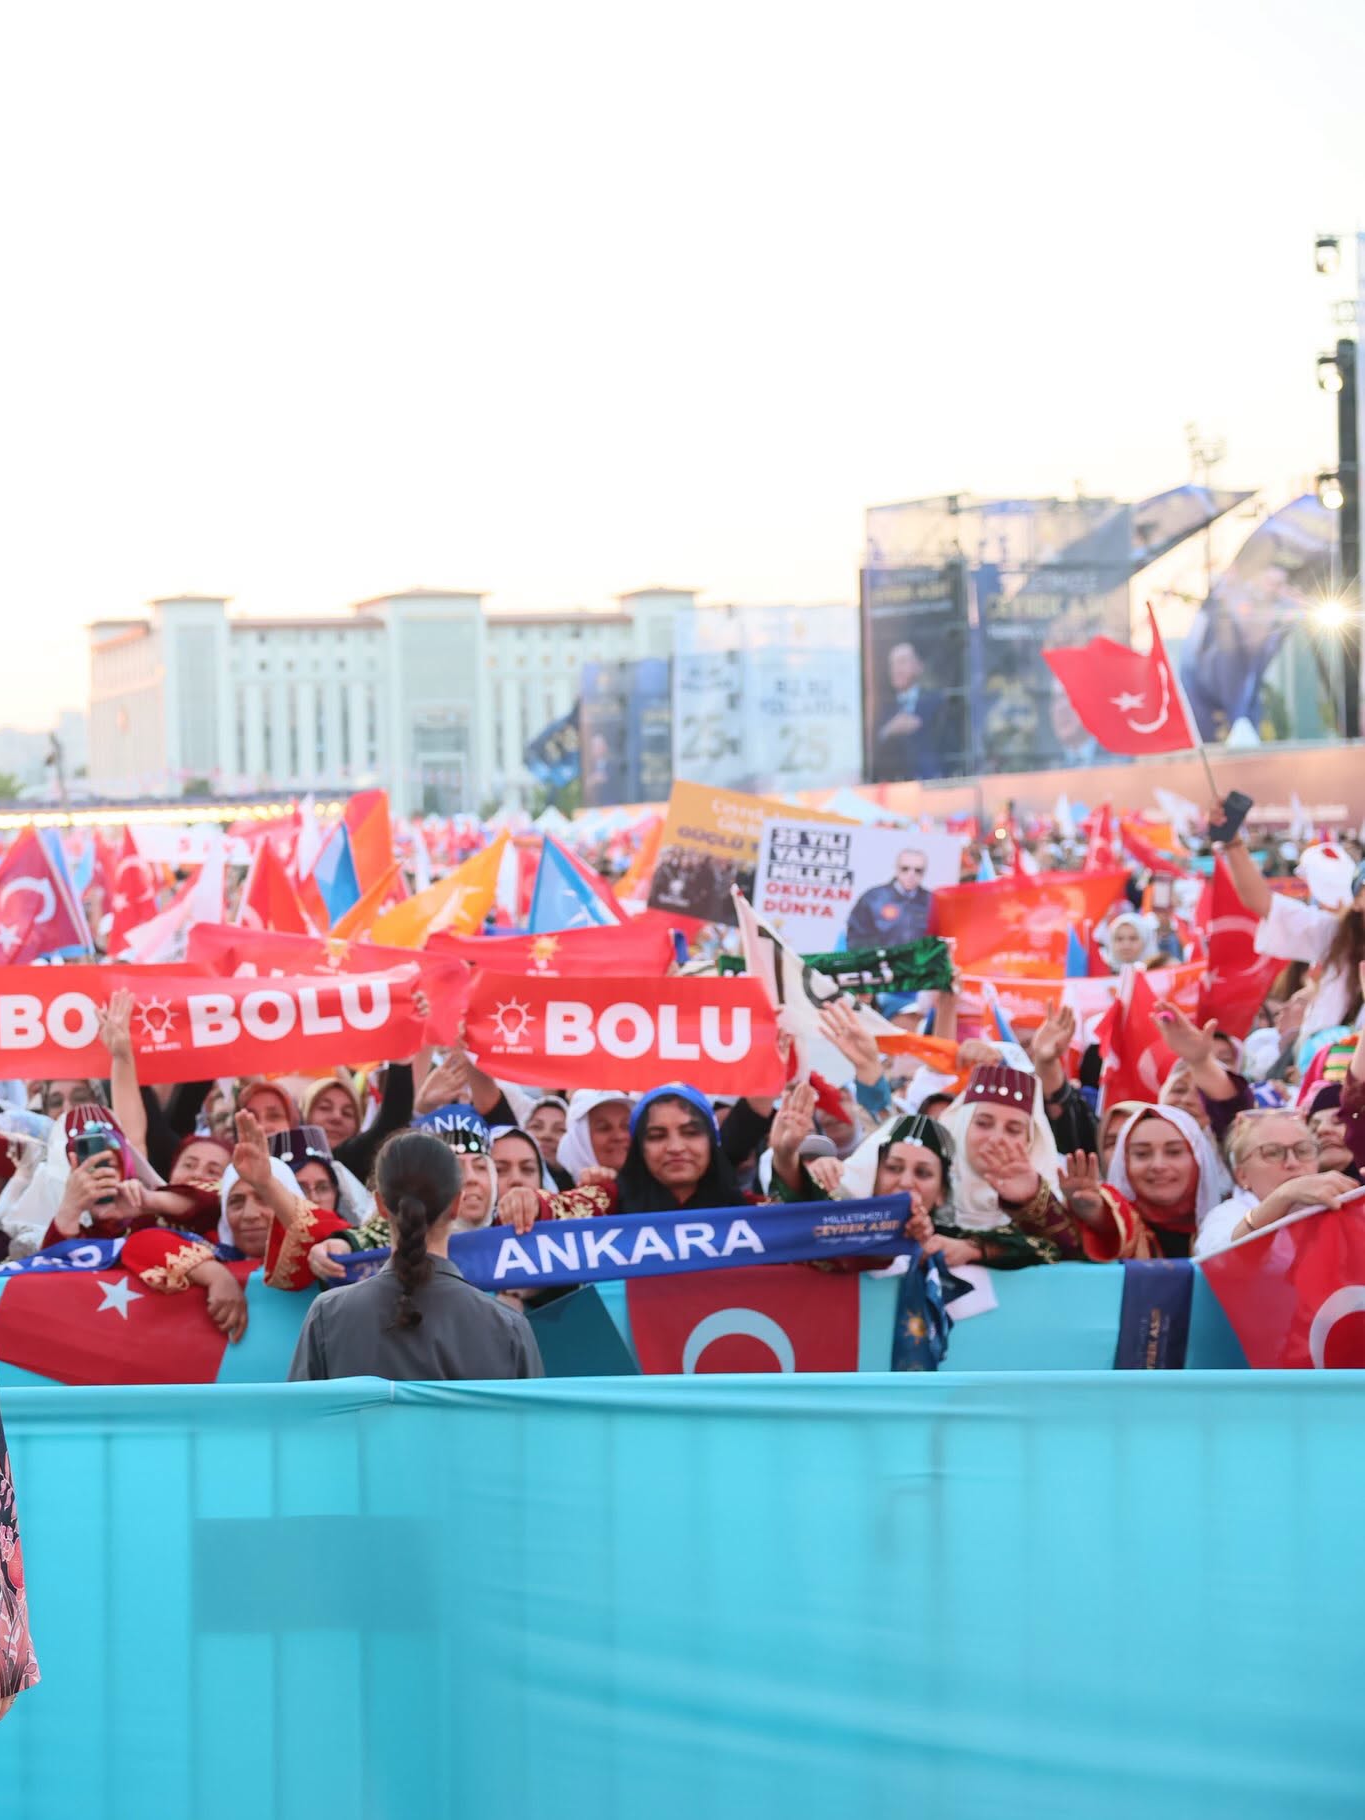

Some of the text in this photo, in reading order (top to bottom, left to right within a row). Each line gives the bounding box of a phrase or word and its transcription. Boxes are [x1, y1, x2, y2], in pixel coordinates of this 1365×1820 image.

[766, 882, 852, 901] OKUYAN
[187, 979, 392, 1048] BOLU
[545, 1000, 752, 1064] BOLU
[493, 1219, 765, 1280] ANKARA
